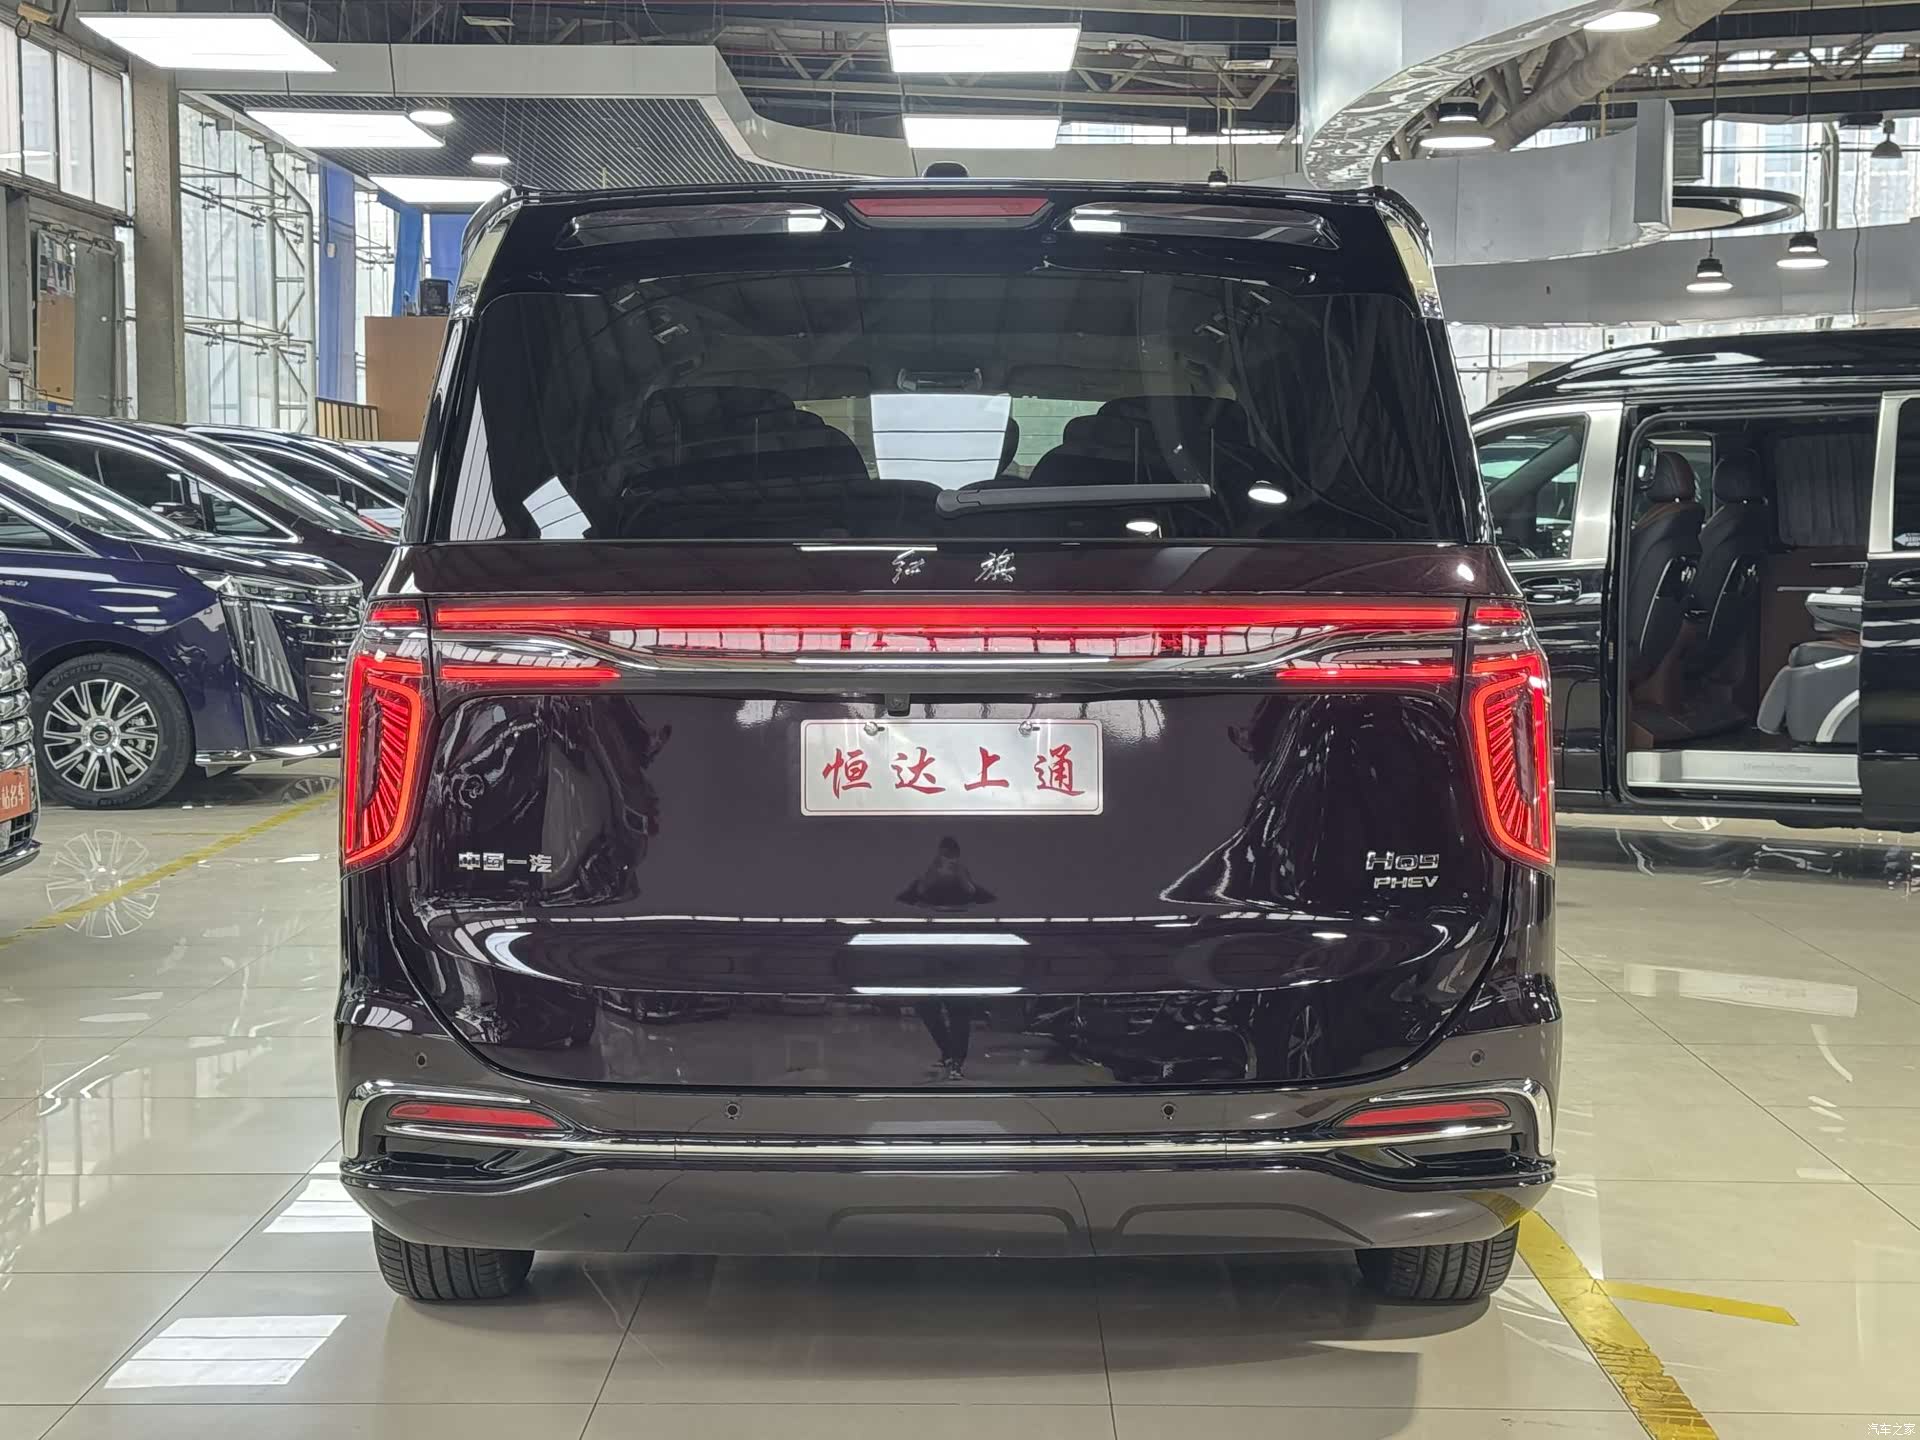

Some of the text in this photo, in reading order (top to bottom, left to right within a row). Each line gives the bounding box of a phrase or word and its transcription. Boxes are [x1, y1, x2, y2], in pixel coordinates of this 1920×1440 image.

[892, 549, 1016, 584] 红旗
[822, 743, 1086, 799] 恒达上通
[0, 781, 26, 809] 站名车
[458, 851, 553, 873] 中国一汽
[1365, 850, 1440, 871] HQ9
[1373, 875, 1439, 889] PHEV
